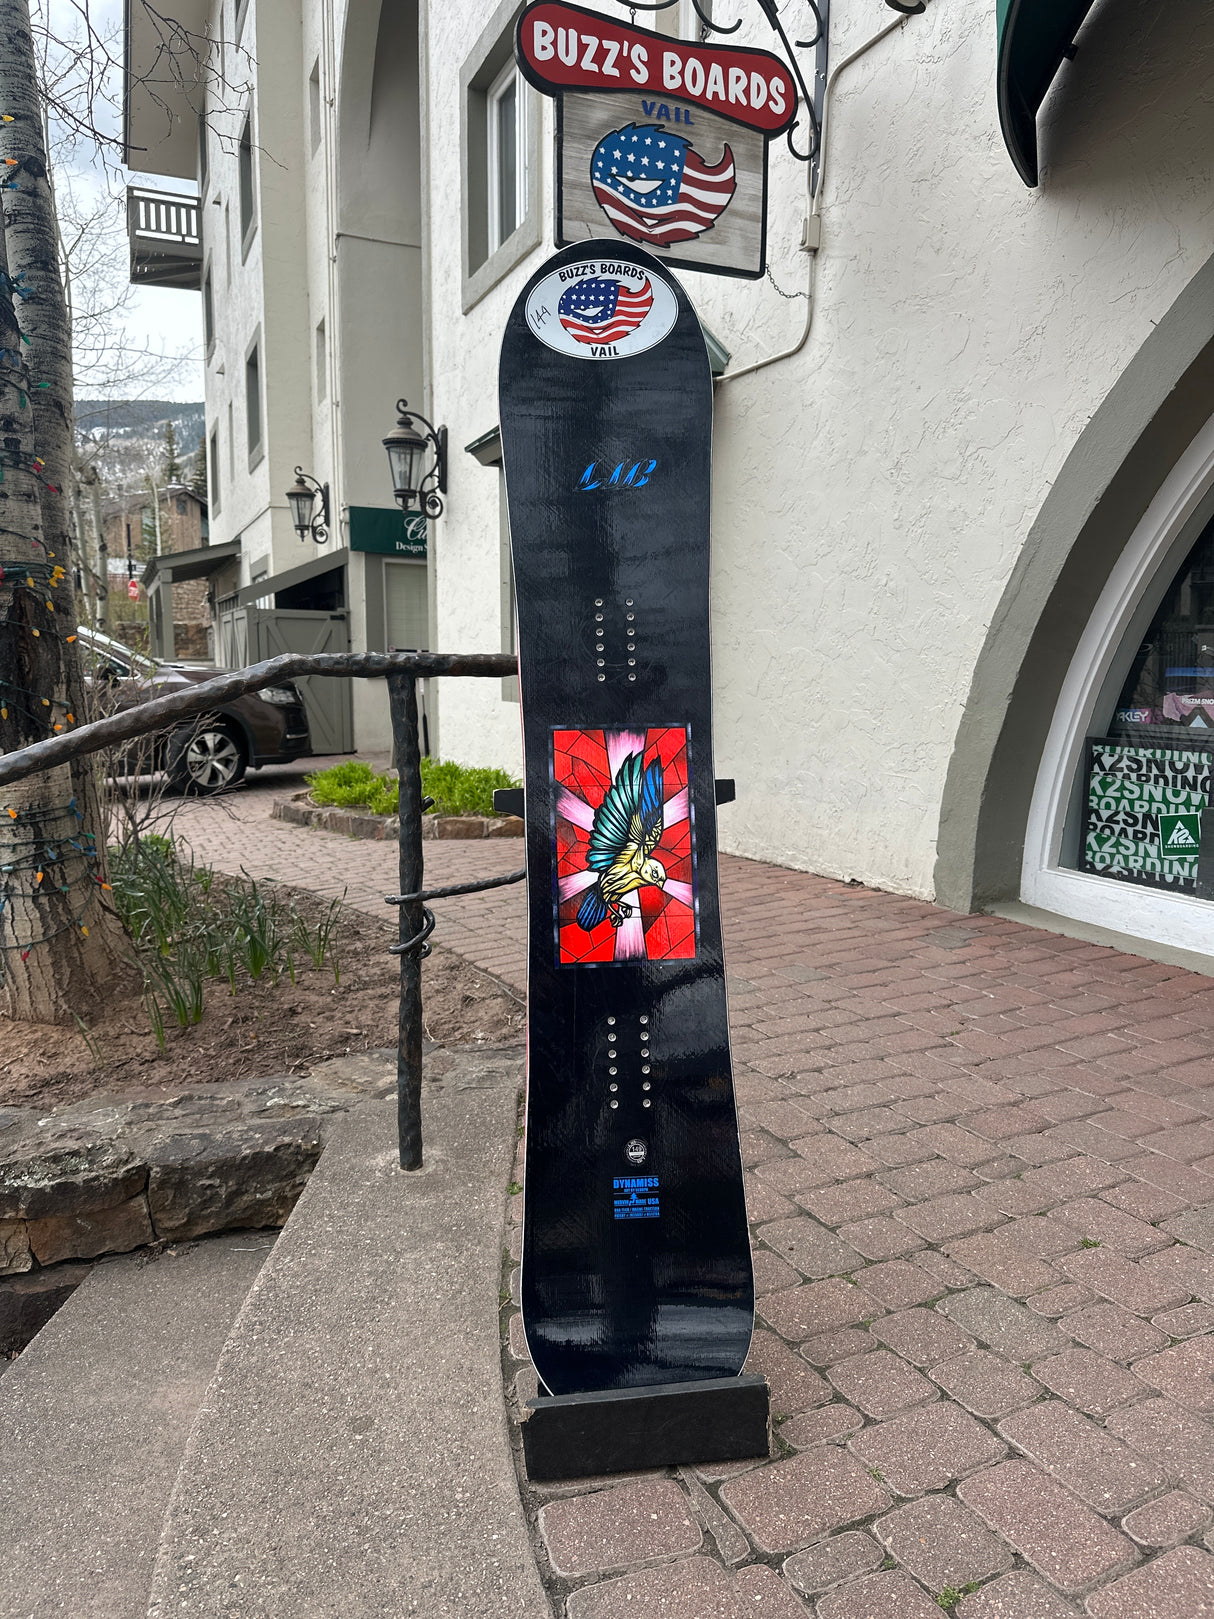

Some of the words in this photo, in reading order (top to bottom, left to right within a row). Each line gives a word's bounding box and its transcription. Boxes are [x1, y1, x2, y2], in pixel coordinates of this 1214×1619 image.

[533, 21, 649, 84] BUZZ'S
[662, 51, 786, 115] BOARDS
[641, 100, 694, 126] VAIL
[558, 263, 596, 283] BUZZ'S
[600, 263, 645, 281] BOARDS
[590, 346, 620, 358] VAIL
[395, 541, 423, 553] Design
[1201, 697, 1214, 705] SNO
[1117, 711, 1149, 722] AKLEY
[613, 1177, 659, 1189] DYNAMISS
